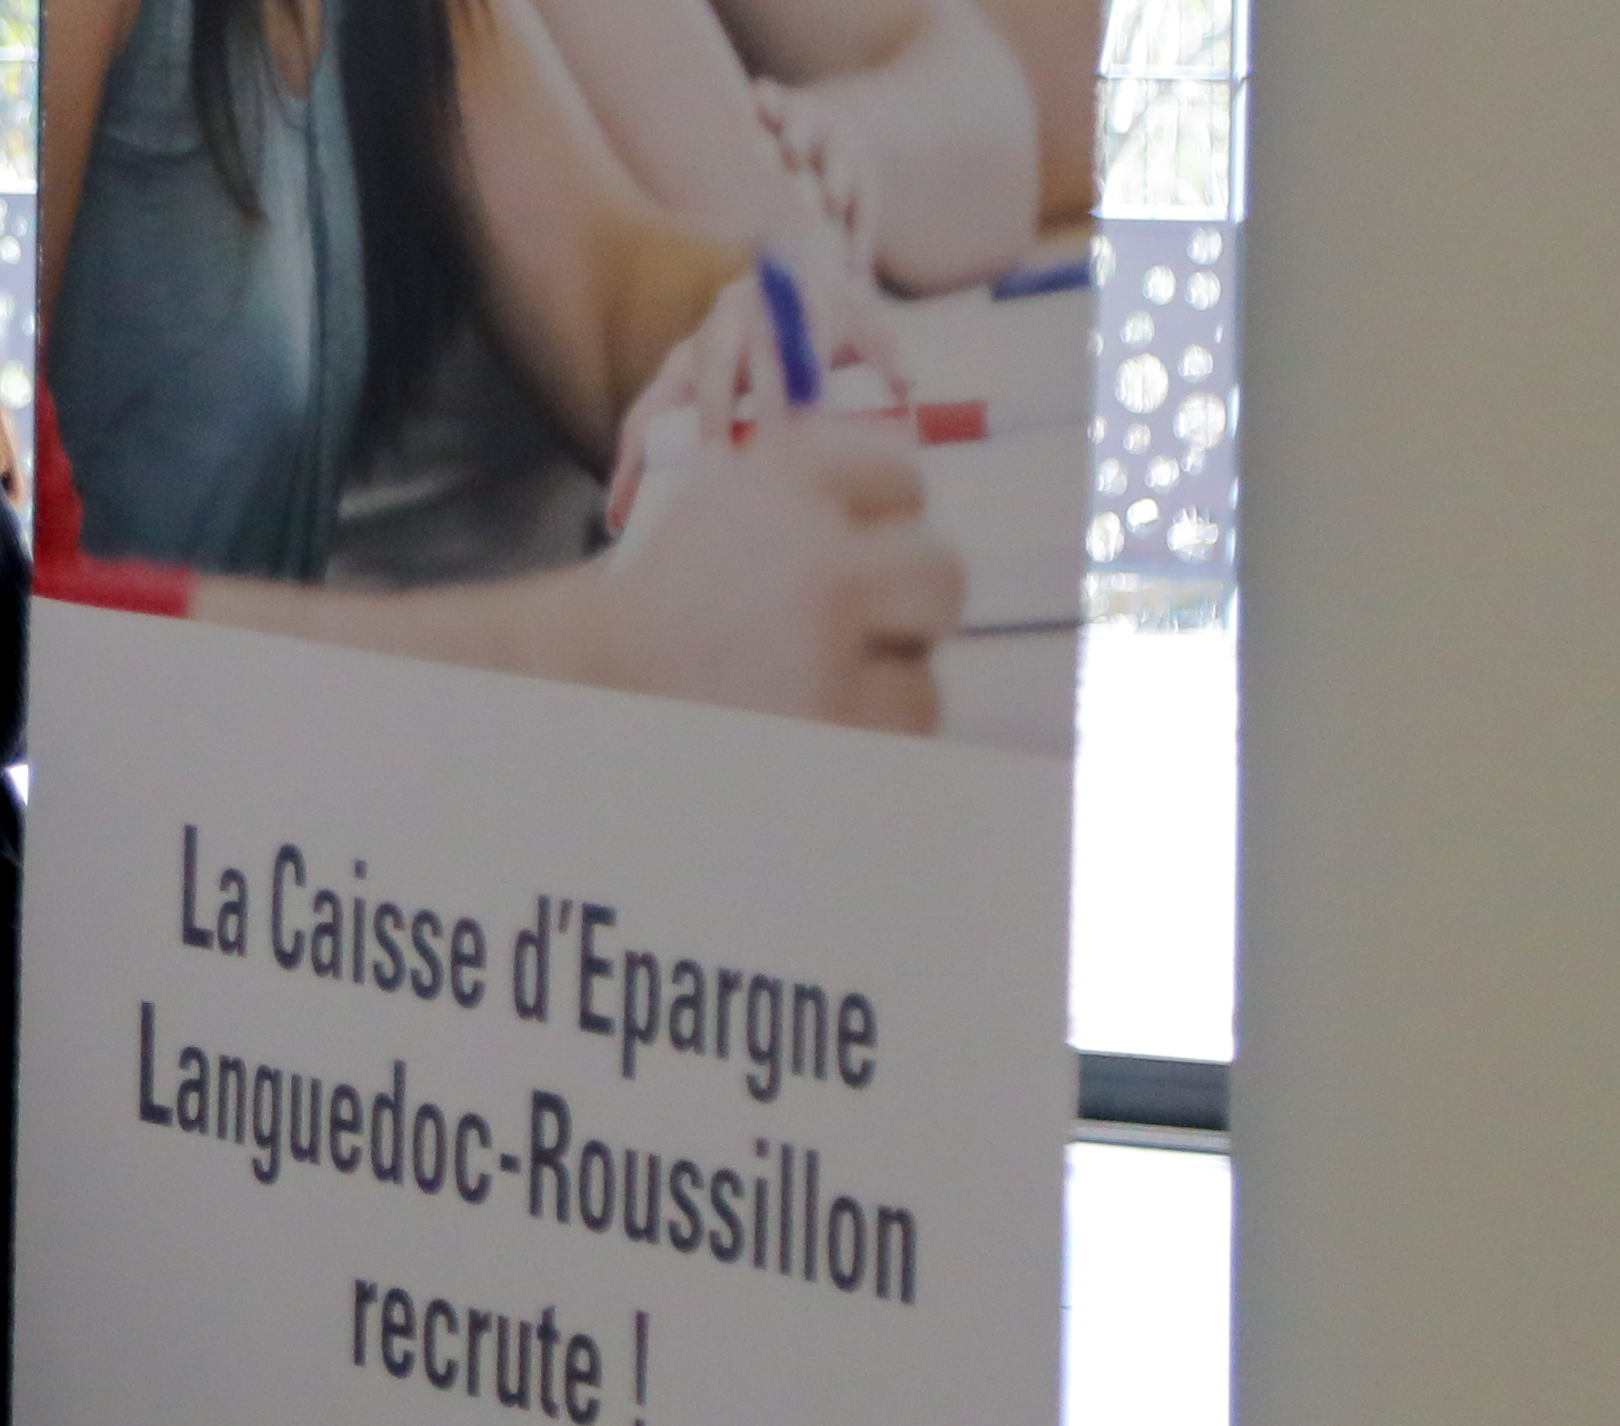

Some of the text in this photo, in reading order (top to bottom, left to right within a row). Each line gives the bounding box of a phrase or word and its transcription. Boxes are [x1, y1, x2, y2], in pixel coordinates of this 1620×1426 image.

[181, 824, 879, 1104] La Caisse d'Epargne
[137, 1001, 919, 1307] Languedoc-Roussillon
